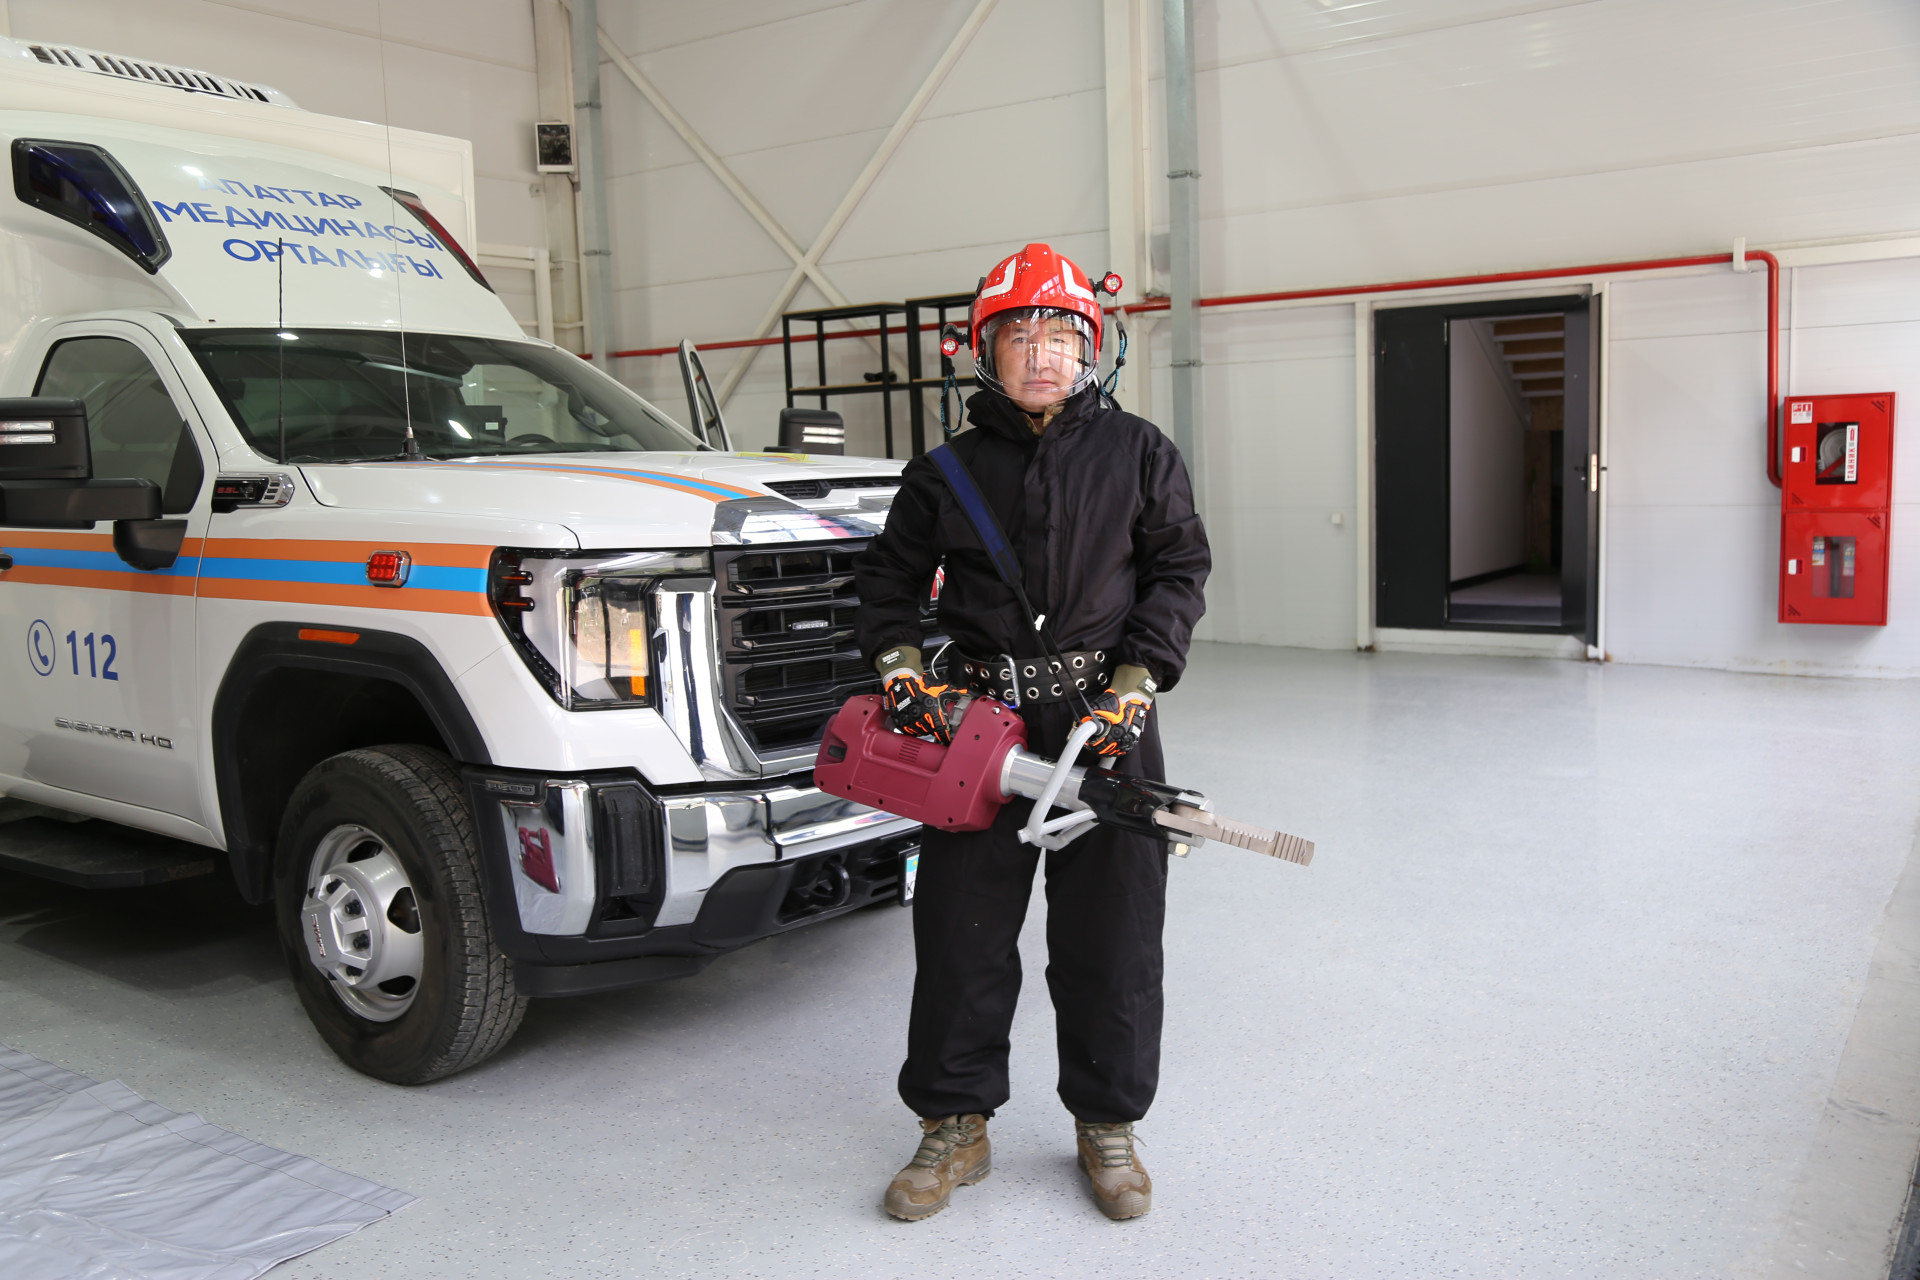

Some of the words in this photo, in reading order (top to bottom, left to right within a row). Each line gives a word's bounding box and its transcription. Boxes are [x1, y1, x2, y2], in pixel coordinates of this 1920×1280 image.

[199, 178, 362, 209] АПАТТАР
[152, 200, 443, 251] МЕДИЦИНАСЫ
[66, 630, 119, 681] 112
[54, 717, 136, 741] SIERRA
[140, 733, 174, 749] HD
